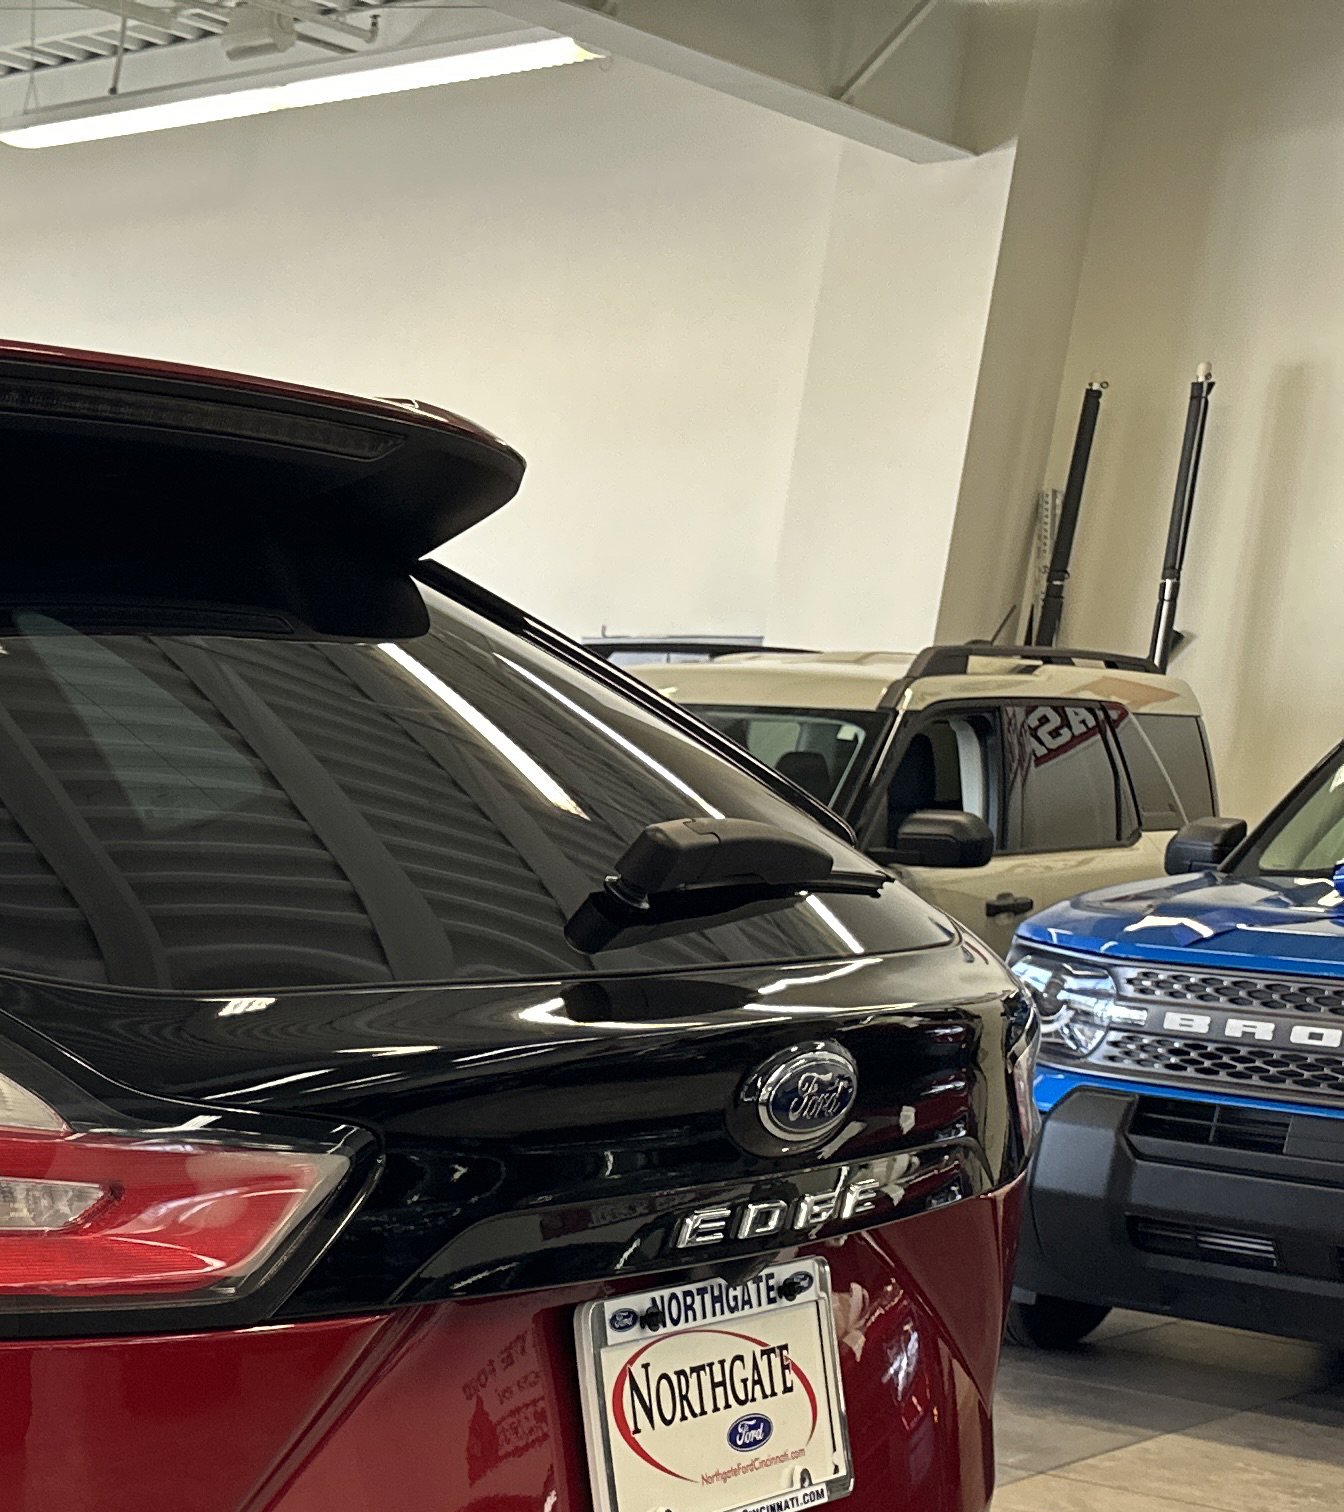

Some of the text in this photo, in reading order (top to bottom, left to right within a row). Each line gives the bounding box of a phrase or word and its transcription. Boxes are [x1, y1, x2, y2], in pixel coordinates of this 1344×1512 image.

[1163, 1011, 1343, 1048] BRO
[788, 1072, 846, 1121] Ford
[628, 1343, 794, 1435] NORTHGATE
[701, 1447, 806, 1487] NorthgateFordCincinnati.com
